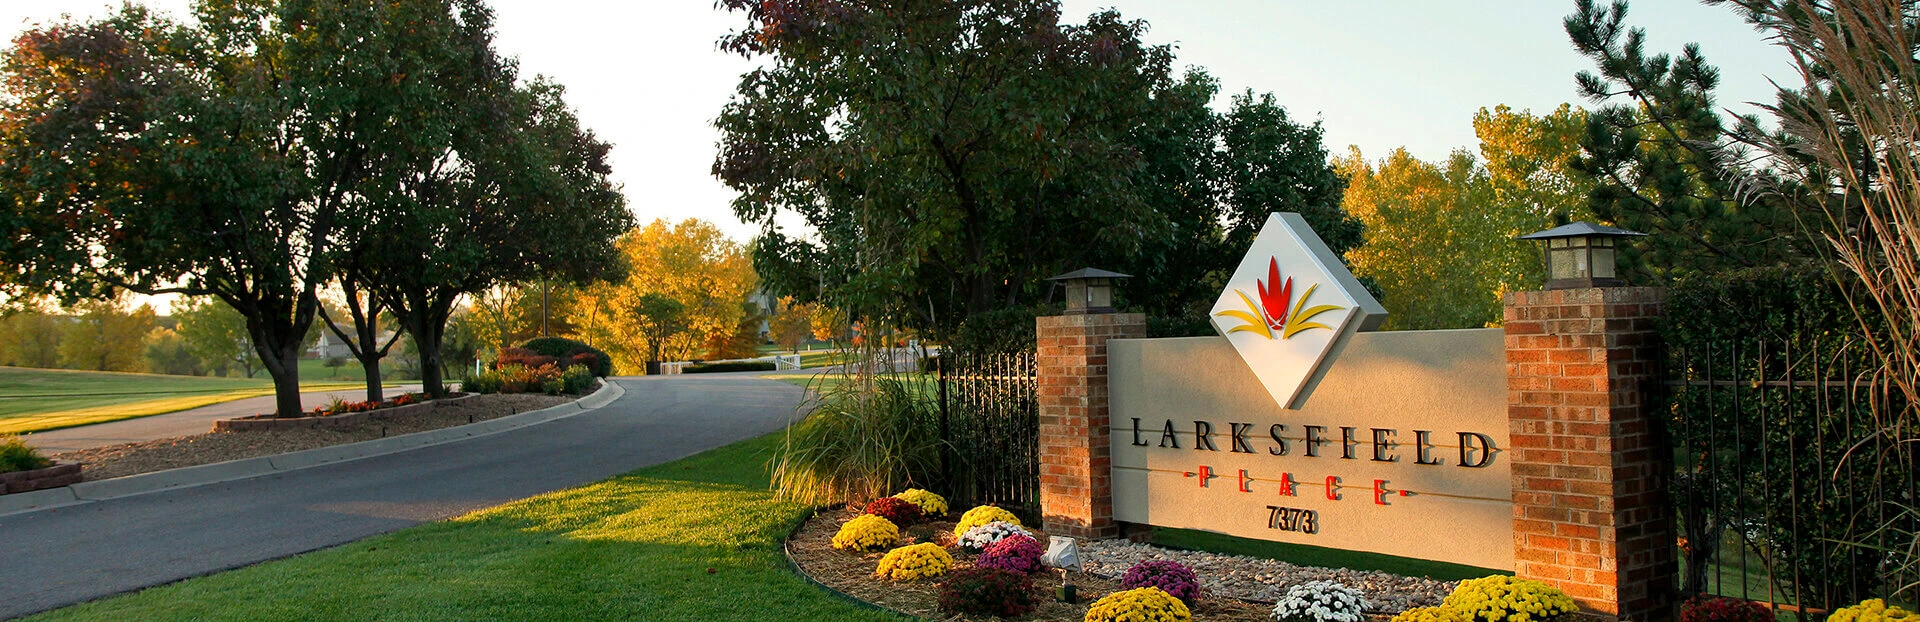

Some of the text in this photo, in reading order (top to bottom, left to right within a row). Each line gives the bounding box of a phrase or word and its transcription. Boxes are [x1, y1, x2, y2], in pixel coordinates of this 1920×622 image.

[1131, 417, 1490, 467] LARKSFIELD
[1199, 465, 1387, 505] PLACE
[1266, 506, 1314, 534] 7373
